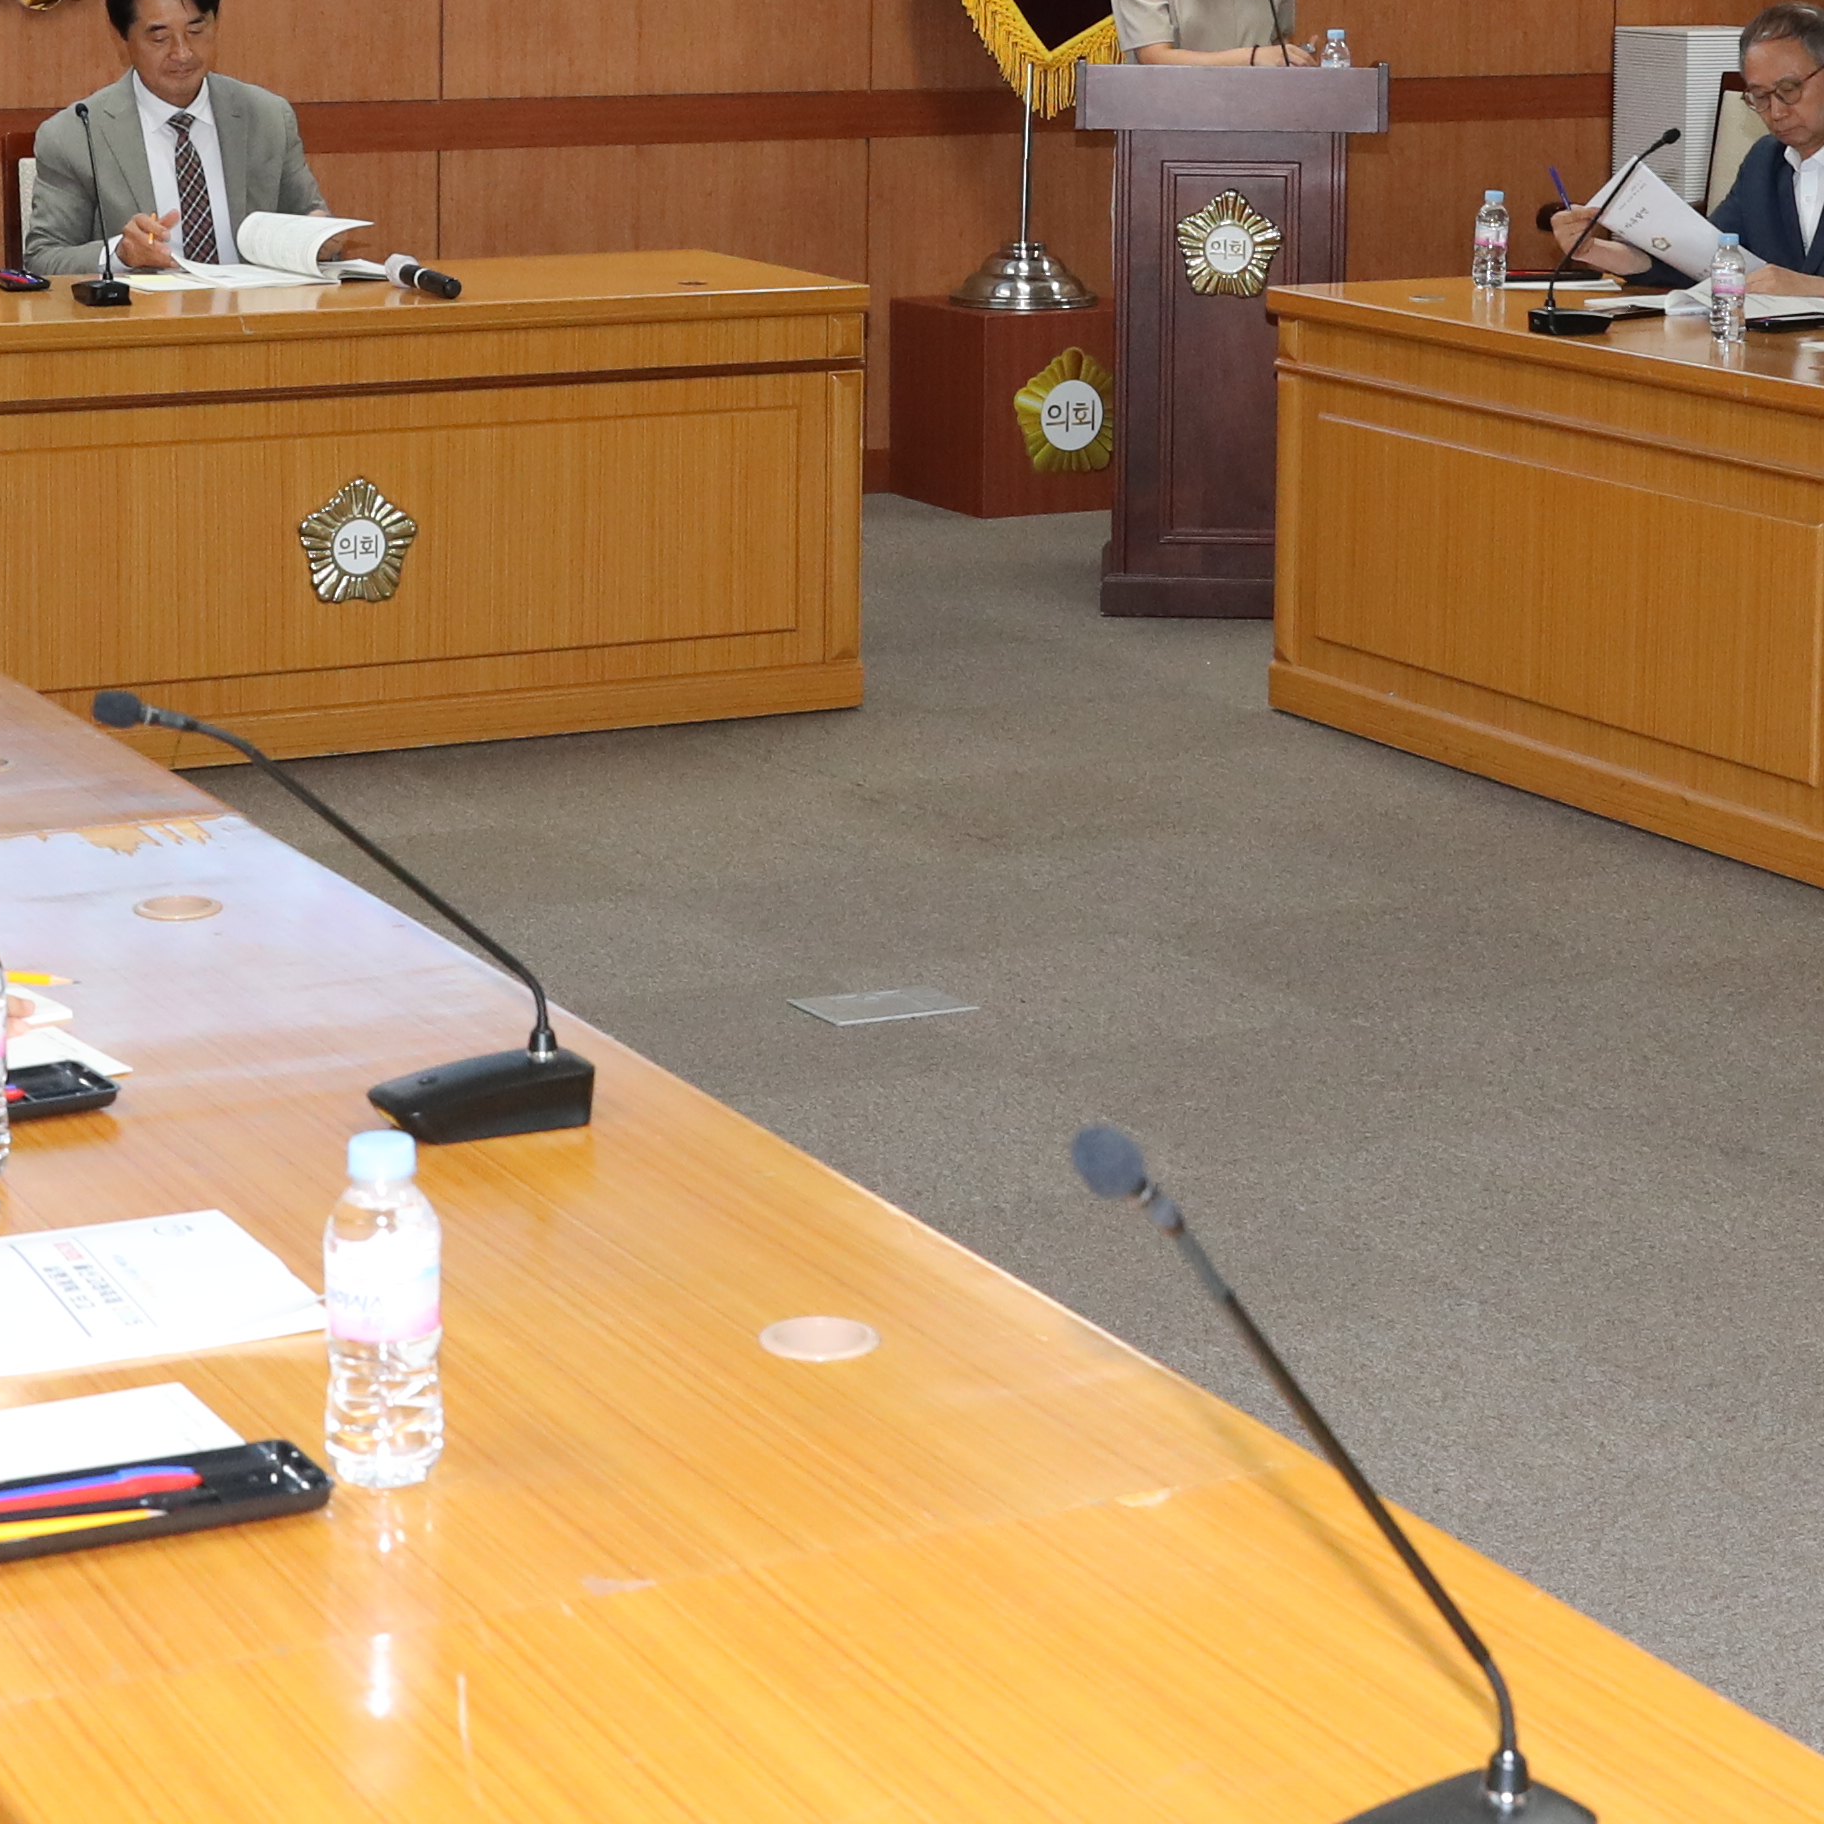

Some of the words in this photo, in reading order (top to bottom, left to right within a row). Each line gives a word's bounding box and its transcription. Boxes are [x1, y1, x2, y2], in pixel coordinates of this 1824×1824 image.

[1209, 239, 1246, 260] 의회
[1046, 400, 1095, 432] 의회
[338, 534, 378, 560] 의회
